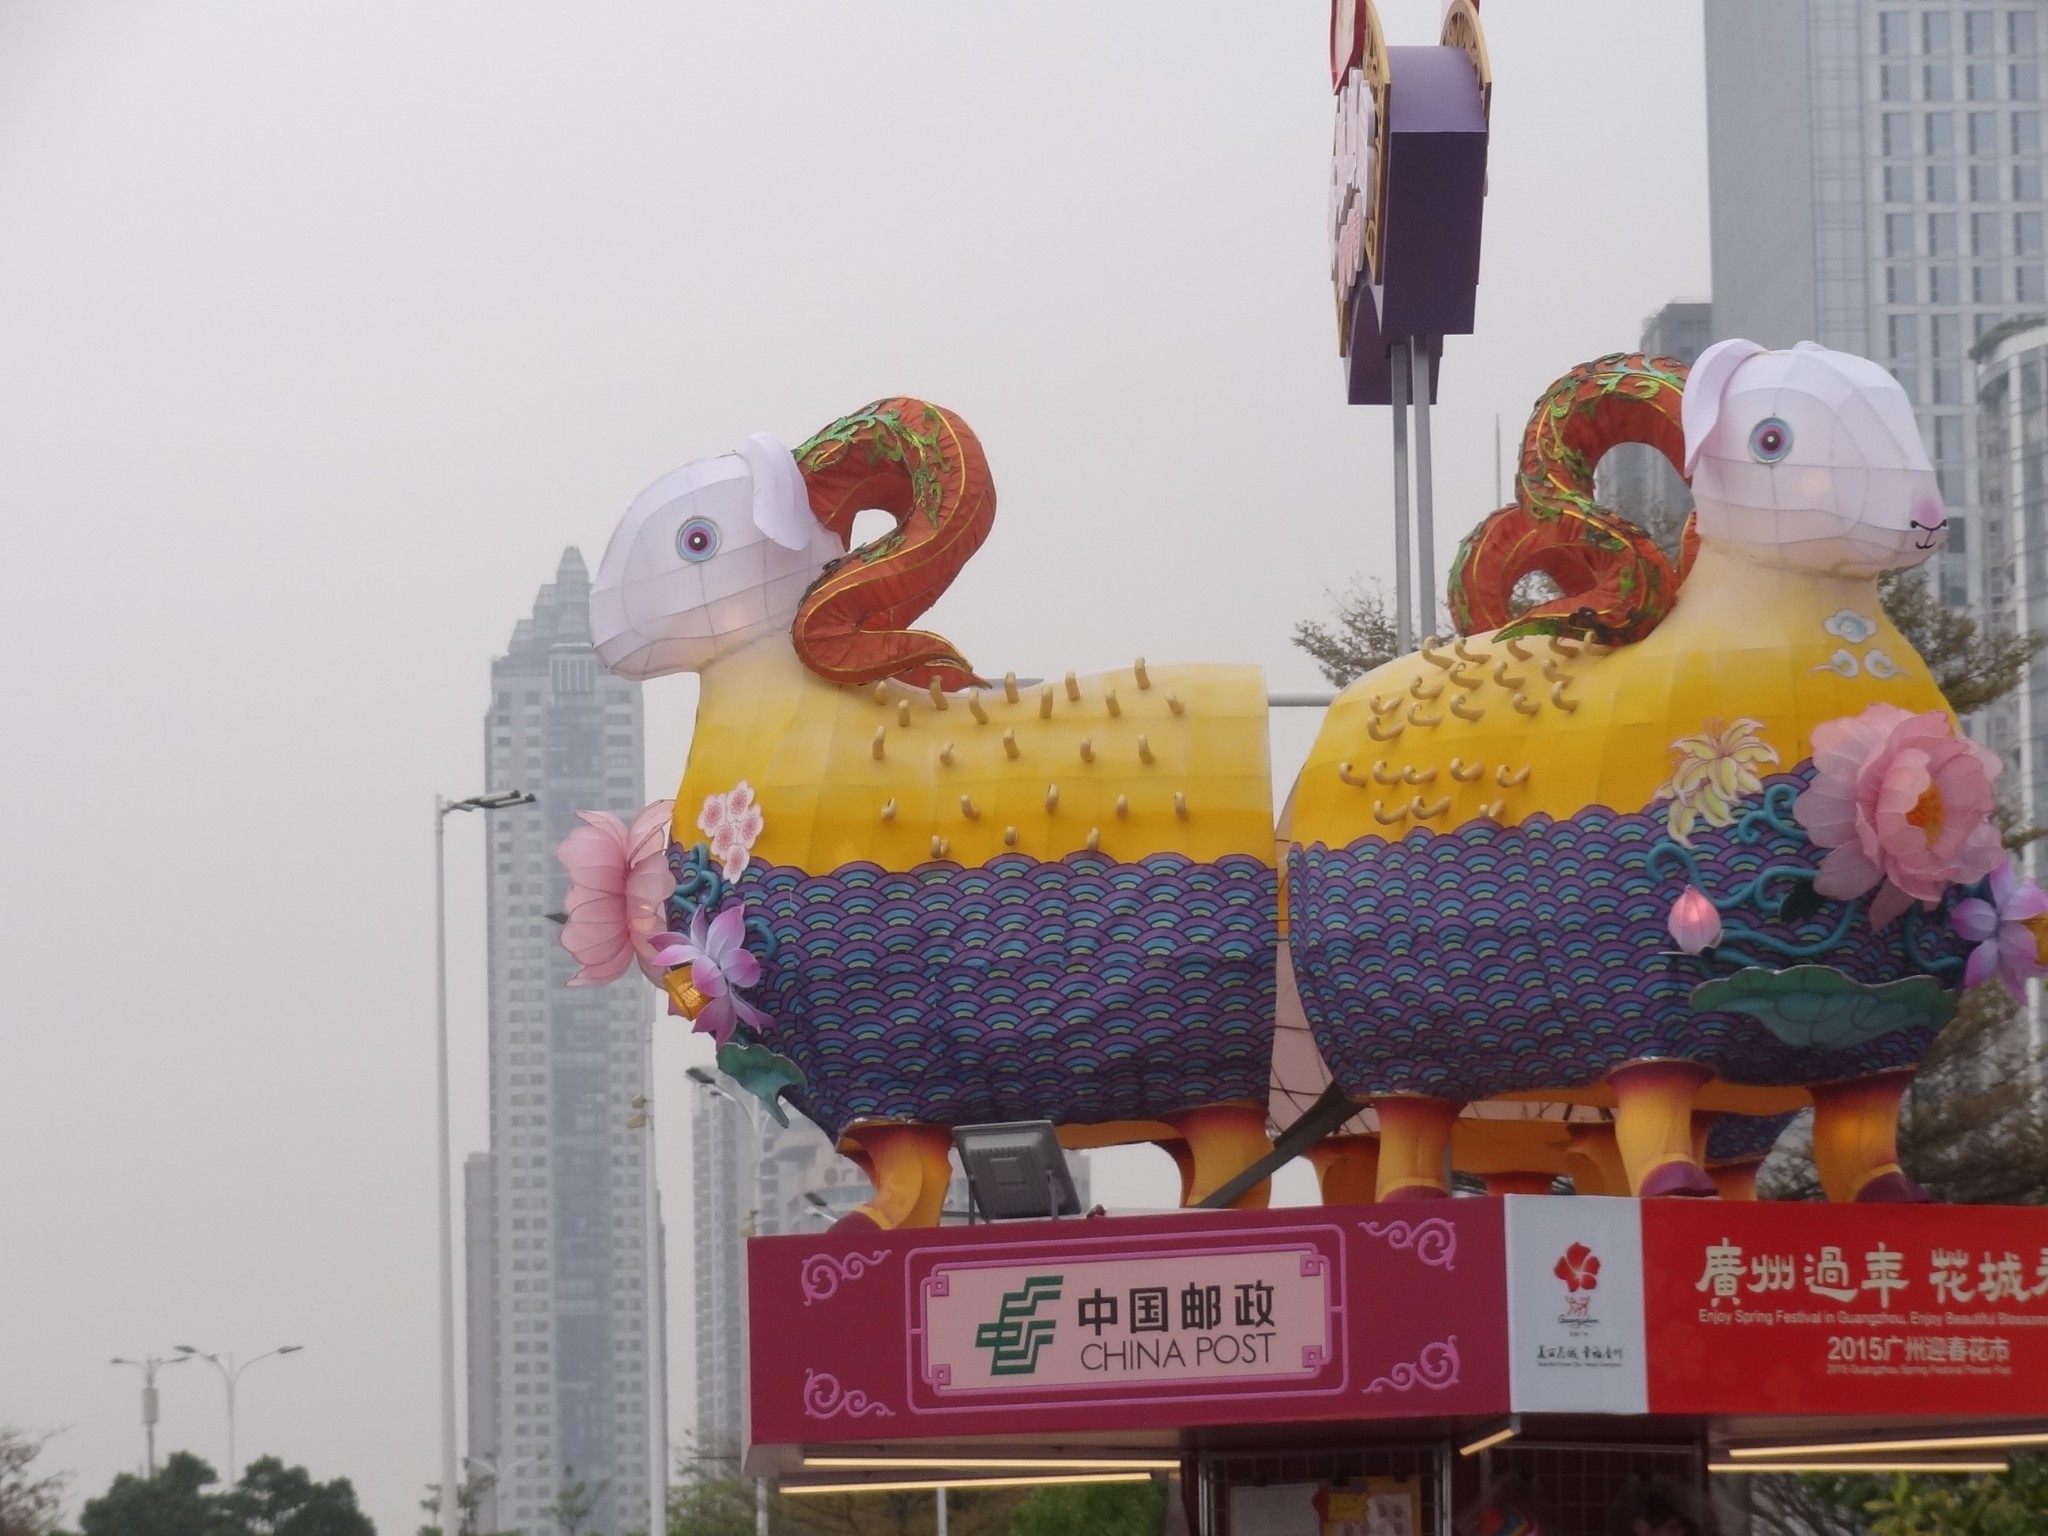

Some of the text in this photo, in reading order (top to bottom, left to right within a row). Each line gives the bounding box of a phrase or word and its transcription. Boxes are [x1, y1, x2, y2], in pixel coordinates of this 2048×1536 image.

[1078, 1280, 1275, 1336] 中国邮政
[1699, 1308, 1732, 1325] Enjoy
[1734, 1309, 1774, 1326] Spring
[1775, 1309, 1821, 1325] Festival
[1823, 1310, 1835, 1324] in
[1910, 1311, 1943, 1327] Enjoy
[1080, 1332, 1276, 1371] CHINA POST
[1827, 1335, 2011, 1362] 2015广州迎春花市
